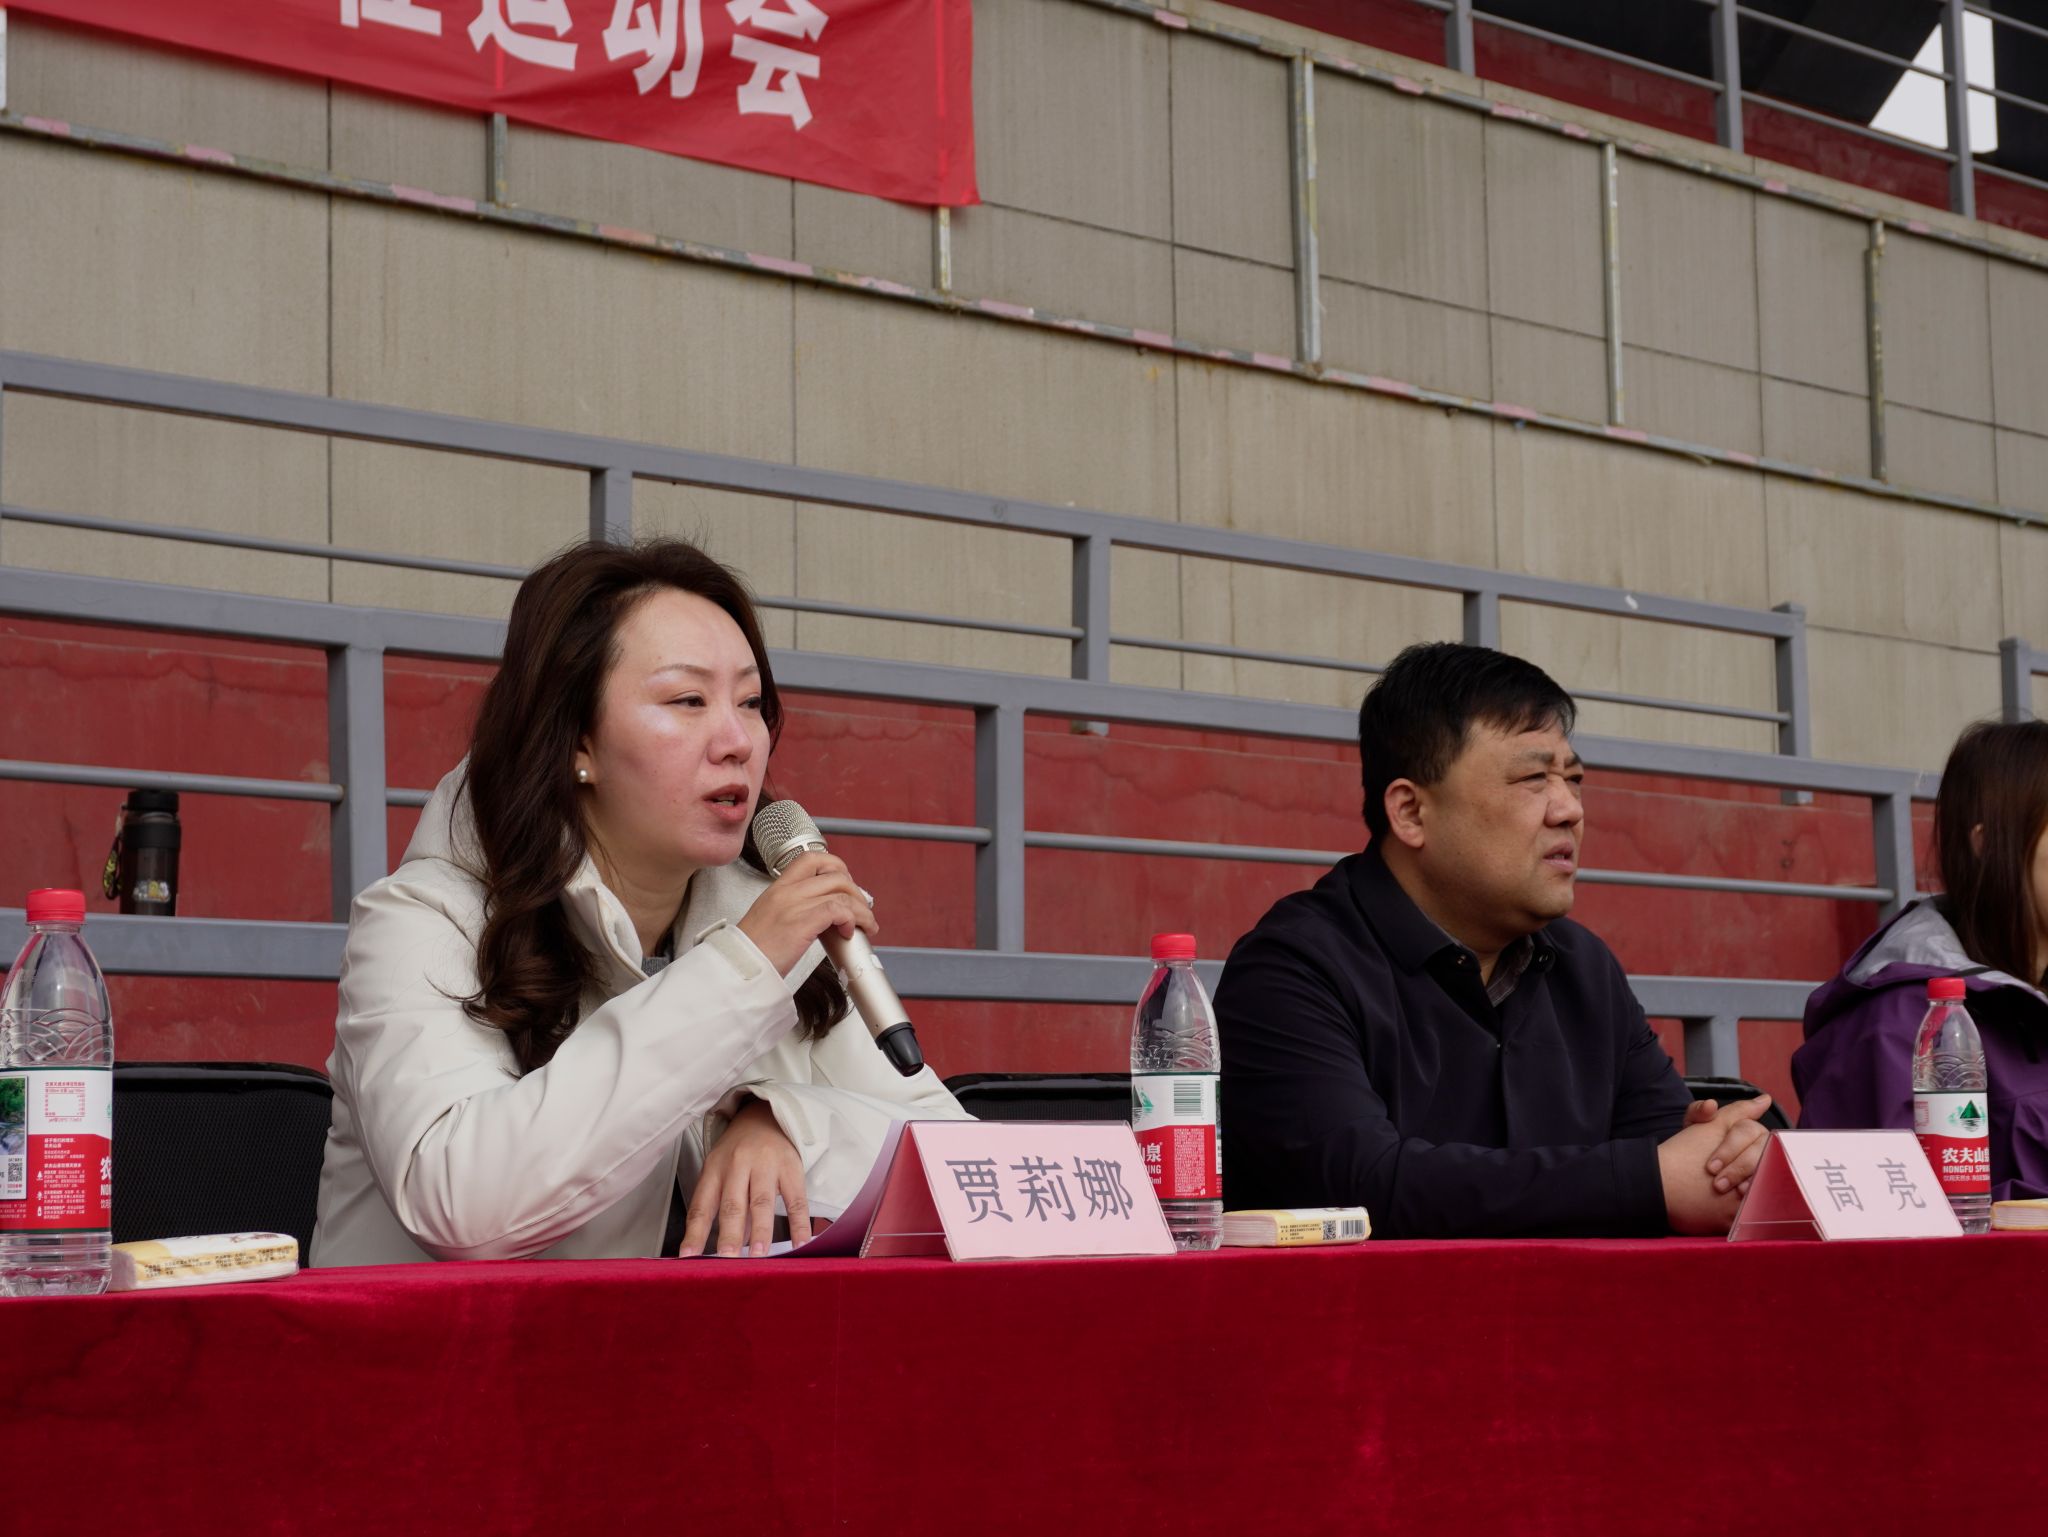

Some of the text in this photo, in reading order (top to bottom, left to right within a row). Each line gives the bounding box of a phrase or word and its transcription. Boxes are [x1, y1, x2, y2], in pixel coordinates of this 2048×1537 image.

[1943, 1165, 1973, 1174] NONGFU
[945, 1156, 1134, 1223] 贾莉娜
